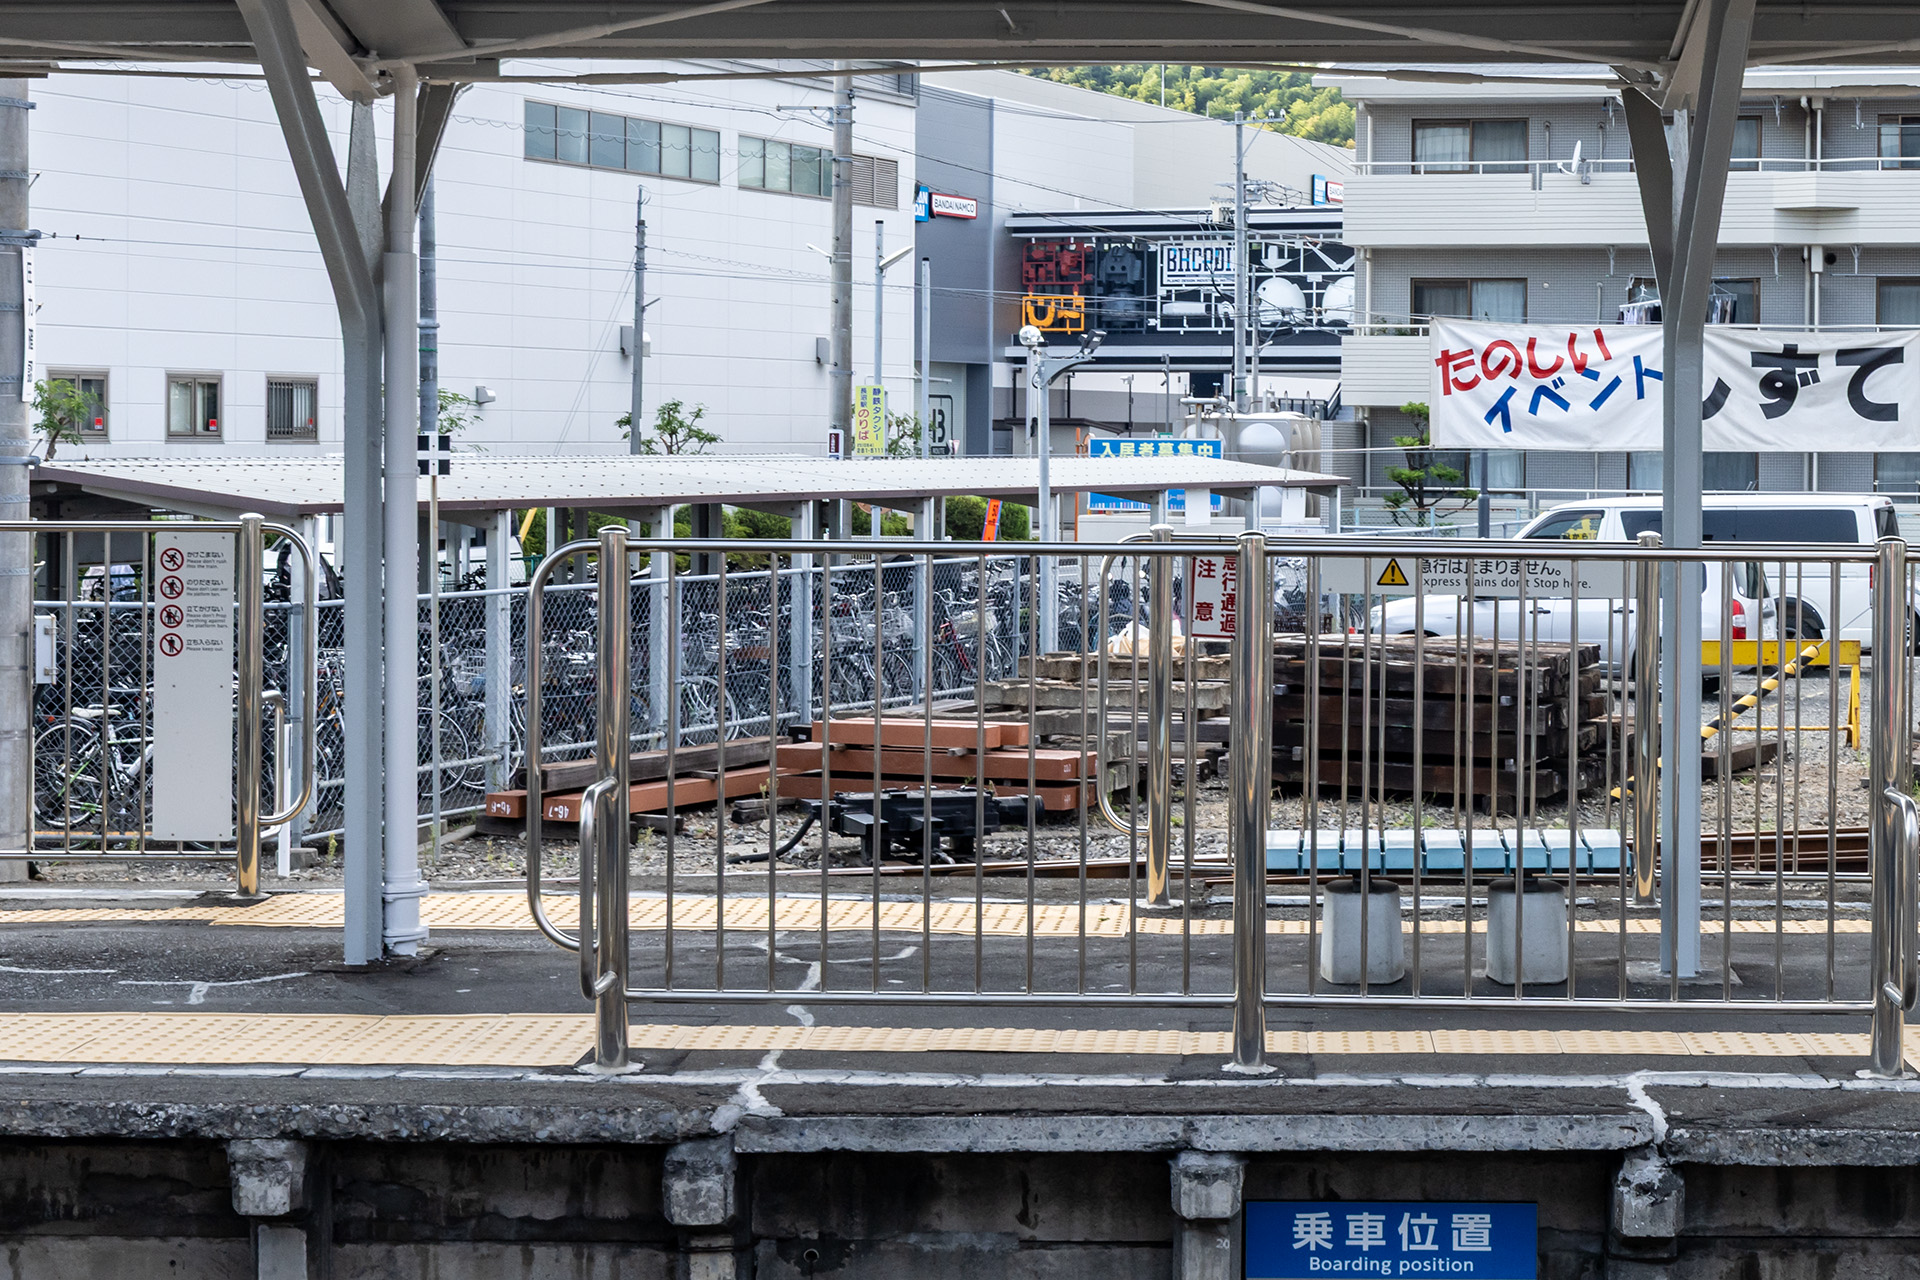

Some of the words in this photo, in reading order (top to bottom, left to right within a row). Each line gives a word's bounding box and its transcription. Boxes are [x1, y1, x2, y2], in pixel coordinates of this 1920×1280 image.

[916, 190, 928, 204] AN
[1167, 247, 1235, 272] BHCPDI
[1434, 328, 1613, 396] たのしい
[1483, 355, 1663, 433] イベント
[1100, 442, 1213, 458] 入居者募集中
[1195, 559, 1216, 621] 注意
[1423, 578, 1461, 588] xpress
[1465, 577, 1497, 587] tains
[1501, 577, 1530, 587] dont
[1534, 577, 1559, 590] Stop
[1563, 578, 1591, 588] hre.
[1292, 1211, 1492, 1251] 乗車位置
[1216, 1238, 1230, 1249] 20
[1309, 1257, 1392, 1275] Boarding
[1399, 1257, 1474, 1275] position
